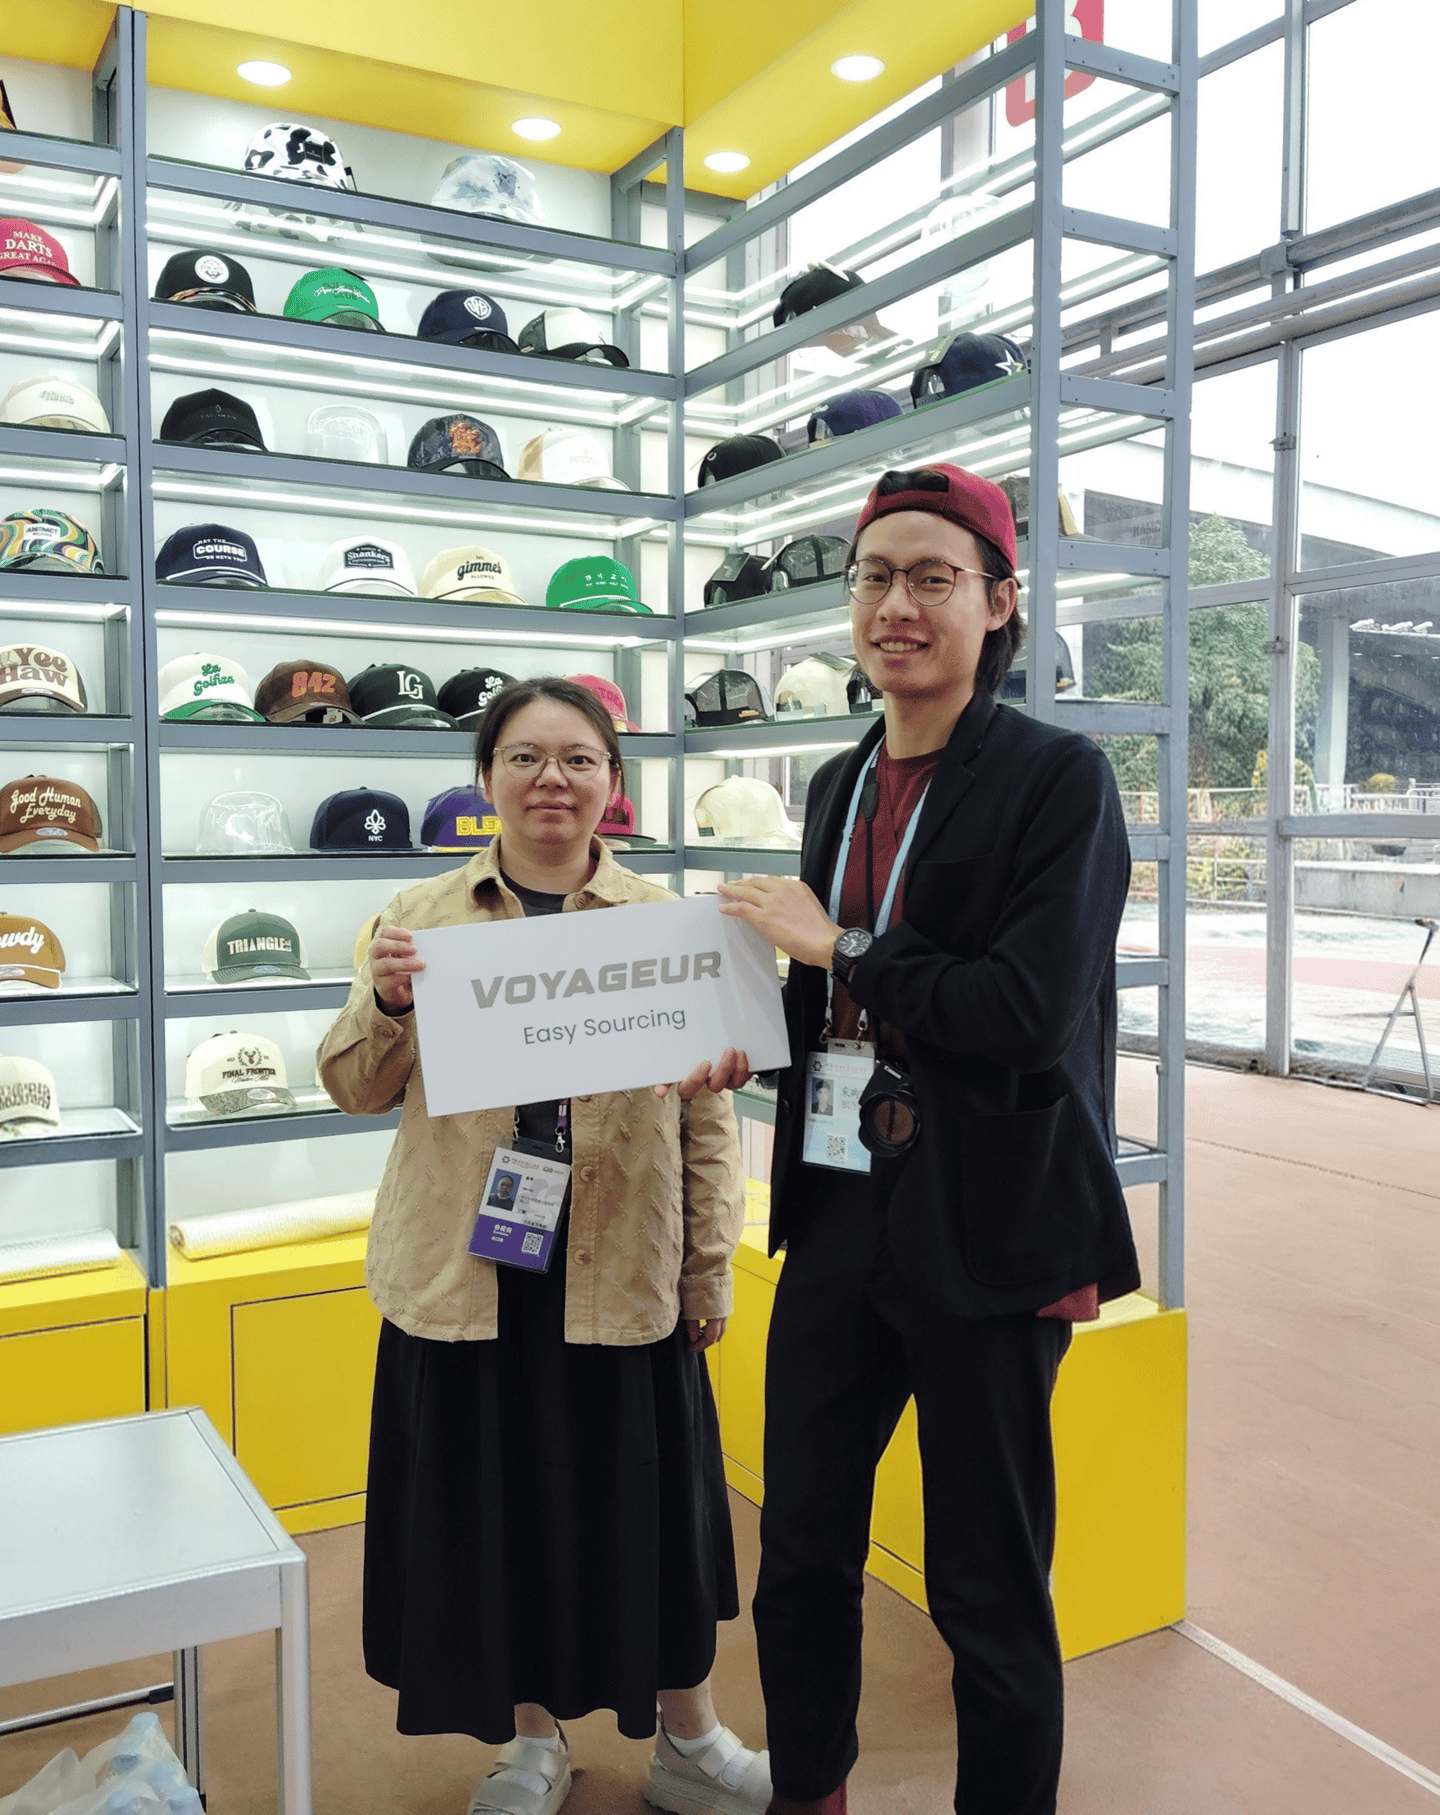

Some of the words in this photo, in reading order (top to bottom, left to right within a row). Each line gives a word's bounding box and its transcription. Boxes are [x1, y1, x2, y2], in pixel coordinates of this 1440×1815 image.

[6, 238, 53, 258] DARTS
[13, 231, 44, 243] MAKE
[196, 544, 245, 558] COURSE
[347, 550, 391, 563] Shankers
[13, 647, 68, 673] Yee
[0, 663, 69, 687] Haw
[291, 670, 336, 698] 842
[396, 670, 424, 699] LG
[10, 786, 38, 814] Good
[38, 786, 82, 808] Human
[20, 803, 76, 824] Everyday
[368, 834, 383, 842] NYC
[471, 951, 722, 1009] VOYAGEUR
[523, 1024, 577, 1045] Easy
[583, 1009, 686, 1036] Sourcing
[222, 1068, 245, 1079] FINAL
[246, 1067, 277, 1077] FRONTIER
